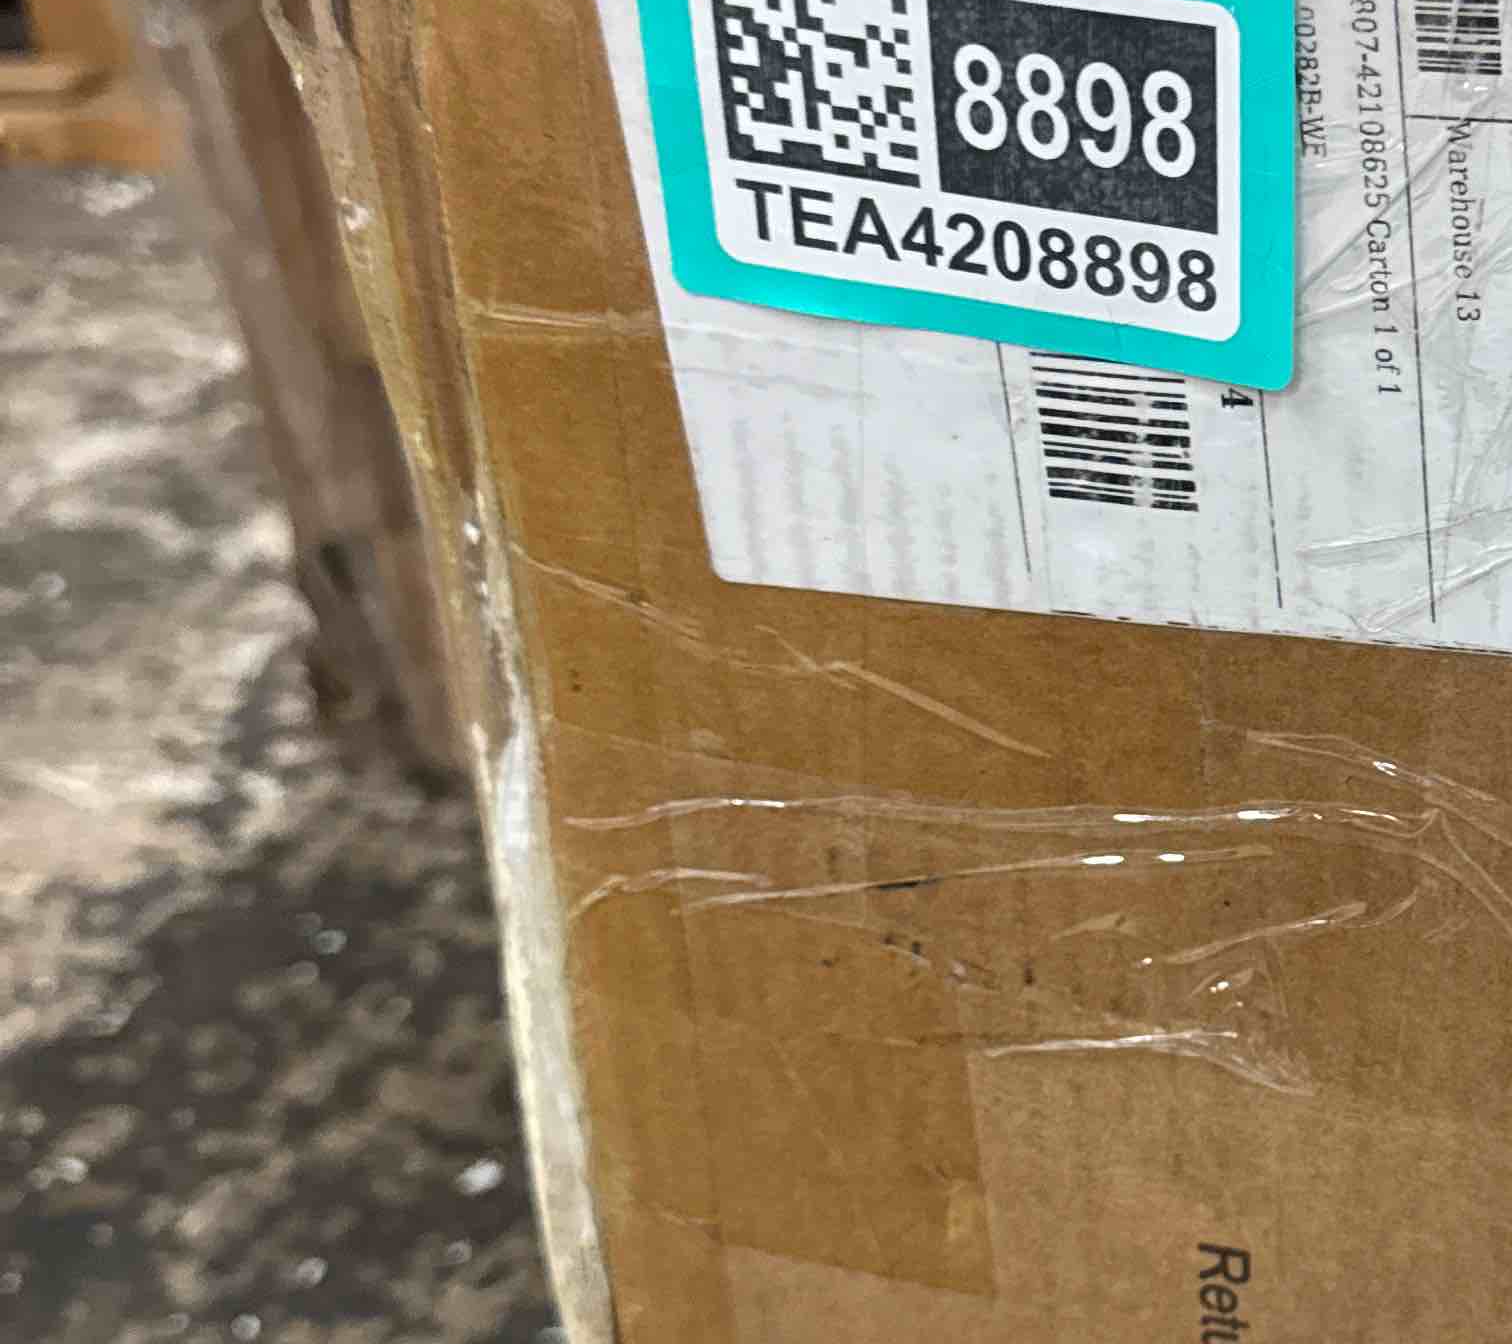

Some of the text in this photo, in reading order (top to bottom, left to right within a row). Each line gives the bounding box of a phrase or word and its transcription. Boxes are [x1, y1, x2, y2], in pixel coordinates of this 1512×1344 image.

[950, 43, 1199, 180] 8898
[733, 176, 1219, 314] TEA4208898
[1366, 219, 1393, 313] Carton
[1446, 119, 1481, 322] Warehouse 13
[1375, 325, 1398, 335] 1
[1376, 349, 1401, 376] of
[1377, 384, 1402, 395] 1
